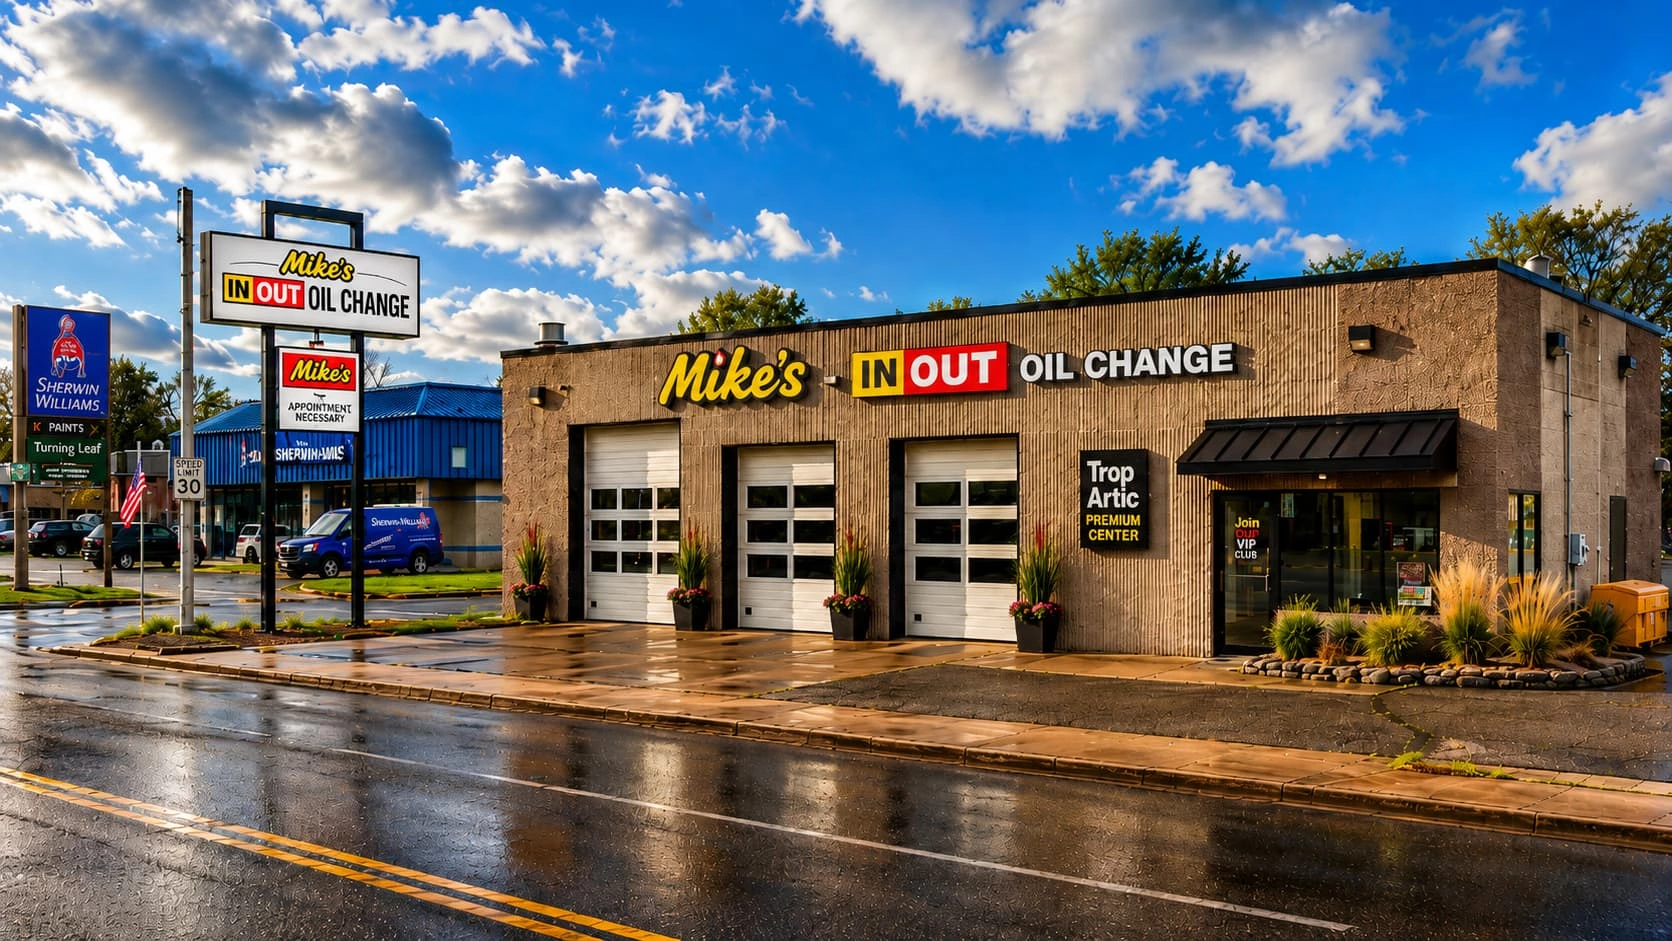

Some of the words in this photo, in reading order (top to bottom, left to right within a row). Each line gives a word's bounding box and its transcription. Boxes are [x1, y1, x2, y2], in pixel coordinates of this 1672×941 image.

[279, 250, 355, 282] Mike's
[228, 278, 249, 299] IN
[256, 281, 301, 305] OUT
[308, 285, 336, 312] OIL
[341, 289, 410, 319] CHANGE
[289, 359, 352, 383] Mike's
[659, 345, 808, 406] Mike's
[861, 358, 897, 389] IN
[910, 350, 998, 387] OUT
[1020, 352, 1074, 383] OIL
[1084, 342, 1234, 380] CHANGE
[36, 377, 100, 396] SHERWIN
[35, 393, 101, 412] WILLIAMS
[288, 402, 352, 414] APPOINTMENT
[295, 412, 345, 423] NECESSARY
[48, 422, 84, 433] PAINTS
[33, 441, 75, 457] Turning
[78, 442, 102, 455] Leaf
[176, 460, 202, 468] SPEED
[177, 469, 200, 477] LIMIT
[1086, 460, 1135, 488] Trop
[177, 478, 201, 494] 30
[1086, 486, 1140, 509] Artic
[1085, 514, 1141, 526] PREMIUM
[1234, 516, 1260, 529] Join
[1088, 529, 1140, 541] CENTER
[1236, 538, 1257, 549] VIP
[1234, 550, 1258, 559] CLUB
